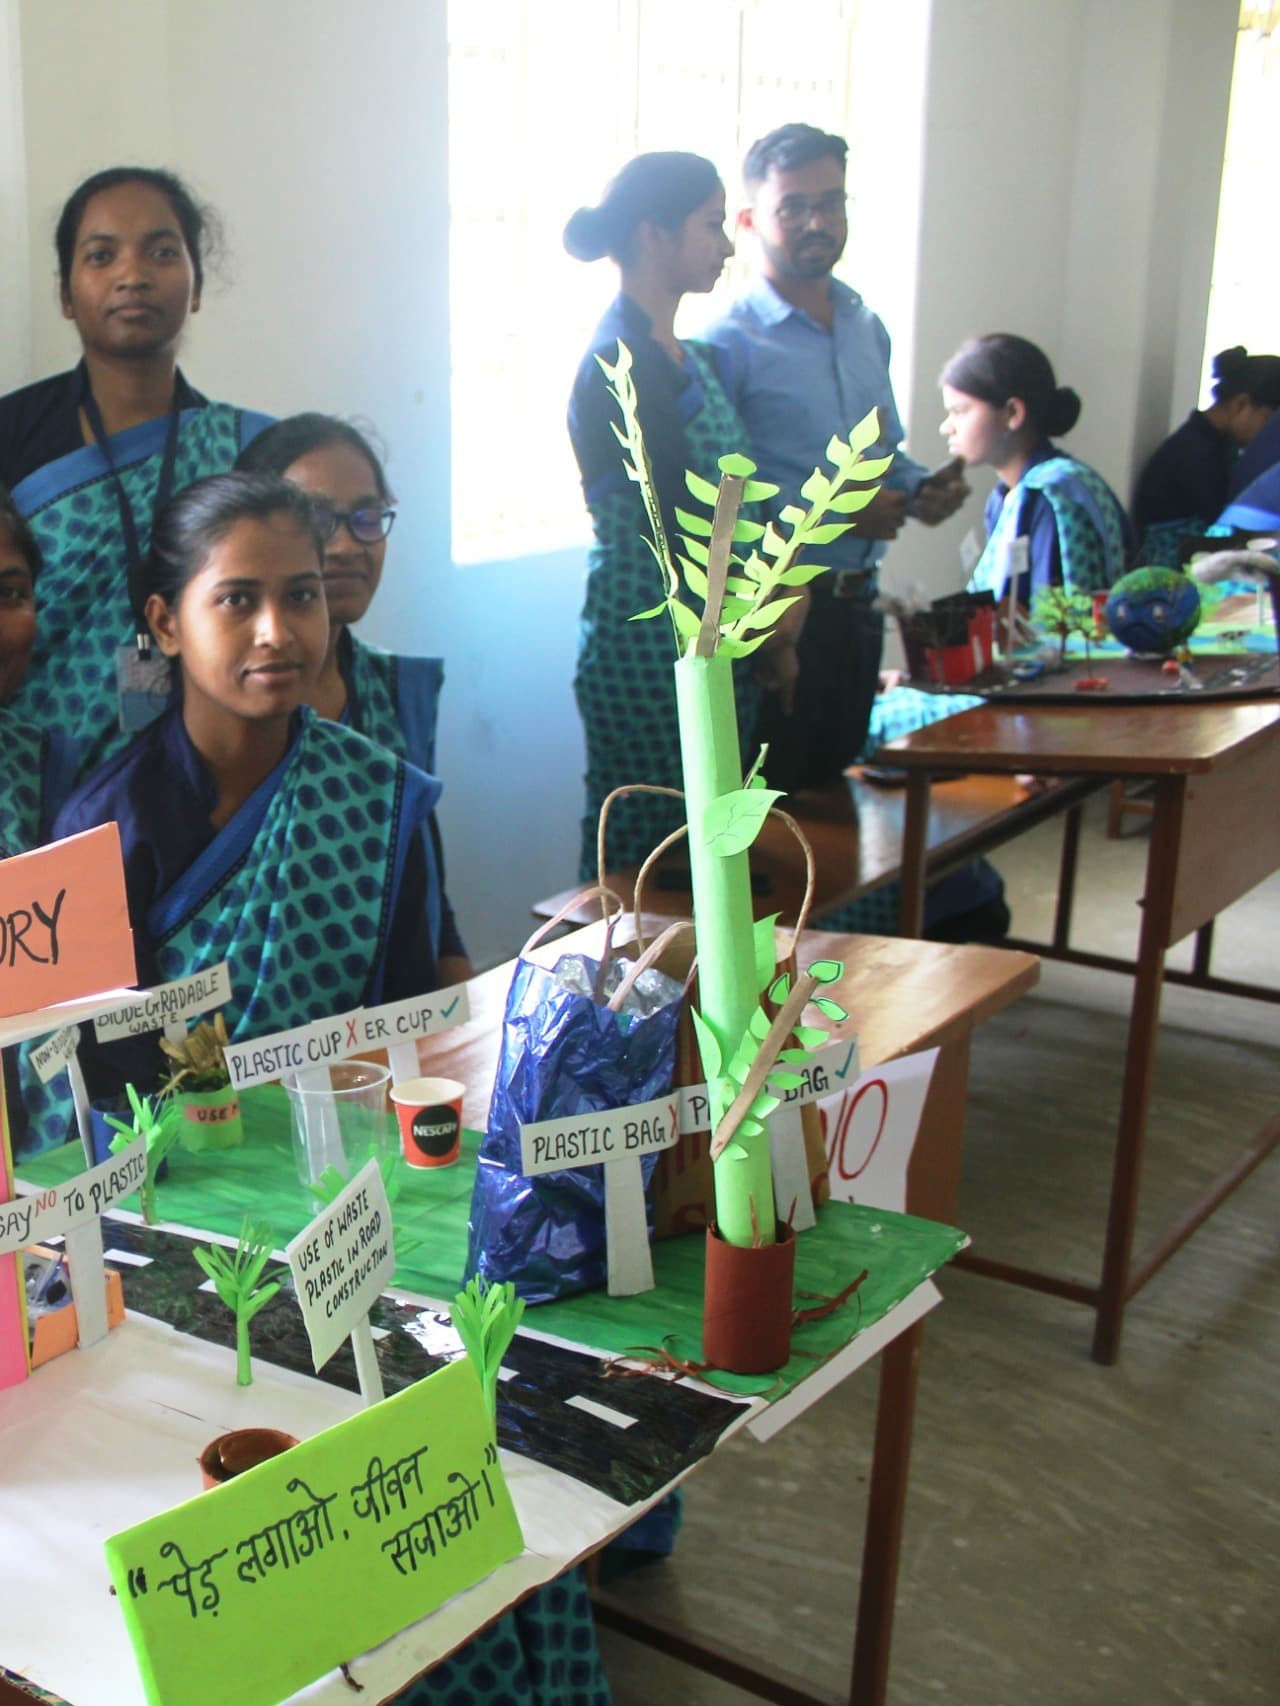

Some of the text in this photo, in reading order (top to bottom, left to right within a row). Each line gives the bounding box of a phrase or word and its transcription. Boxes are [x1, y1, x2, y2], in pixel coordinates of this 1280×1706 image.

[129, 1012, 178, 1033] WASTE
[396, 1009, 433, 1033] CUP
[231, 1031, 342, 1082] PLASTIC CUP
[197, 1106, 227, 1122] USE
[532, 1116, 666, 1164] PLASTIC BAG
[35, 1190, 57, 1217] NO
[64, 1188, 85, 1216] TO
[89, 1153, 145, 1214] PLASTIC
[298, 1239, 320, 1271] USE
[337, 1188, 369, 1236] WASTE
[305, 1211, 381, 1307] PLASTIC IN ROAD
[327, 1240, 388, 1318] CONSTRUCTION
[350, 1446, 429, 1523] जीवन
